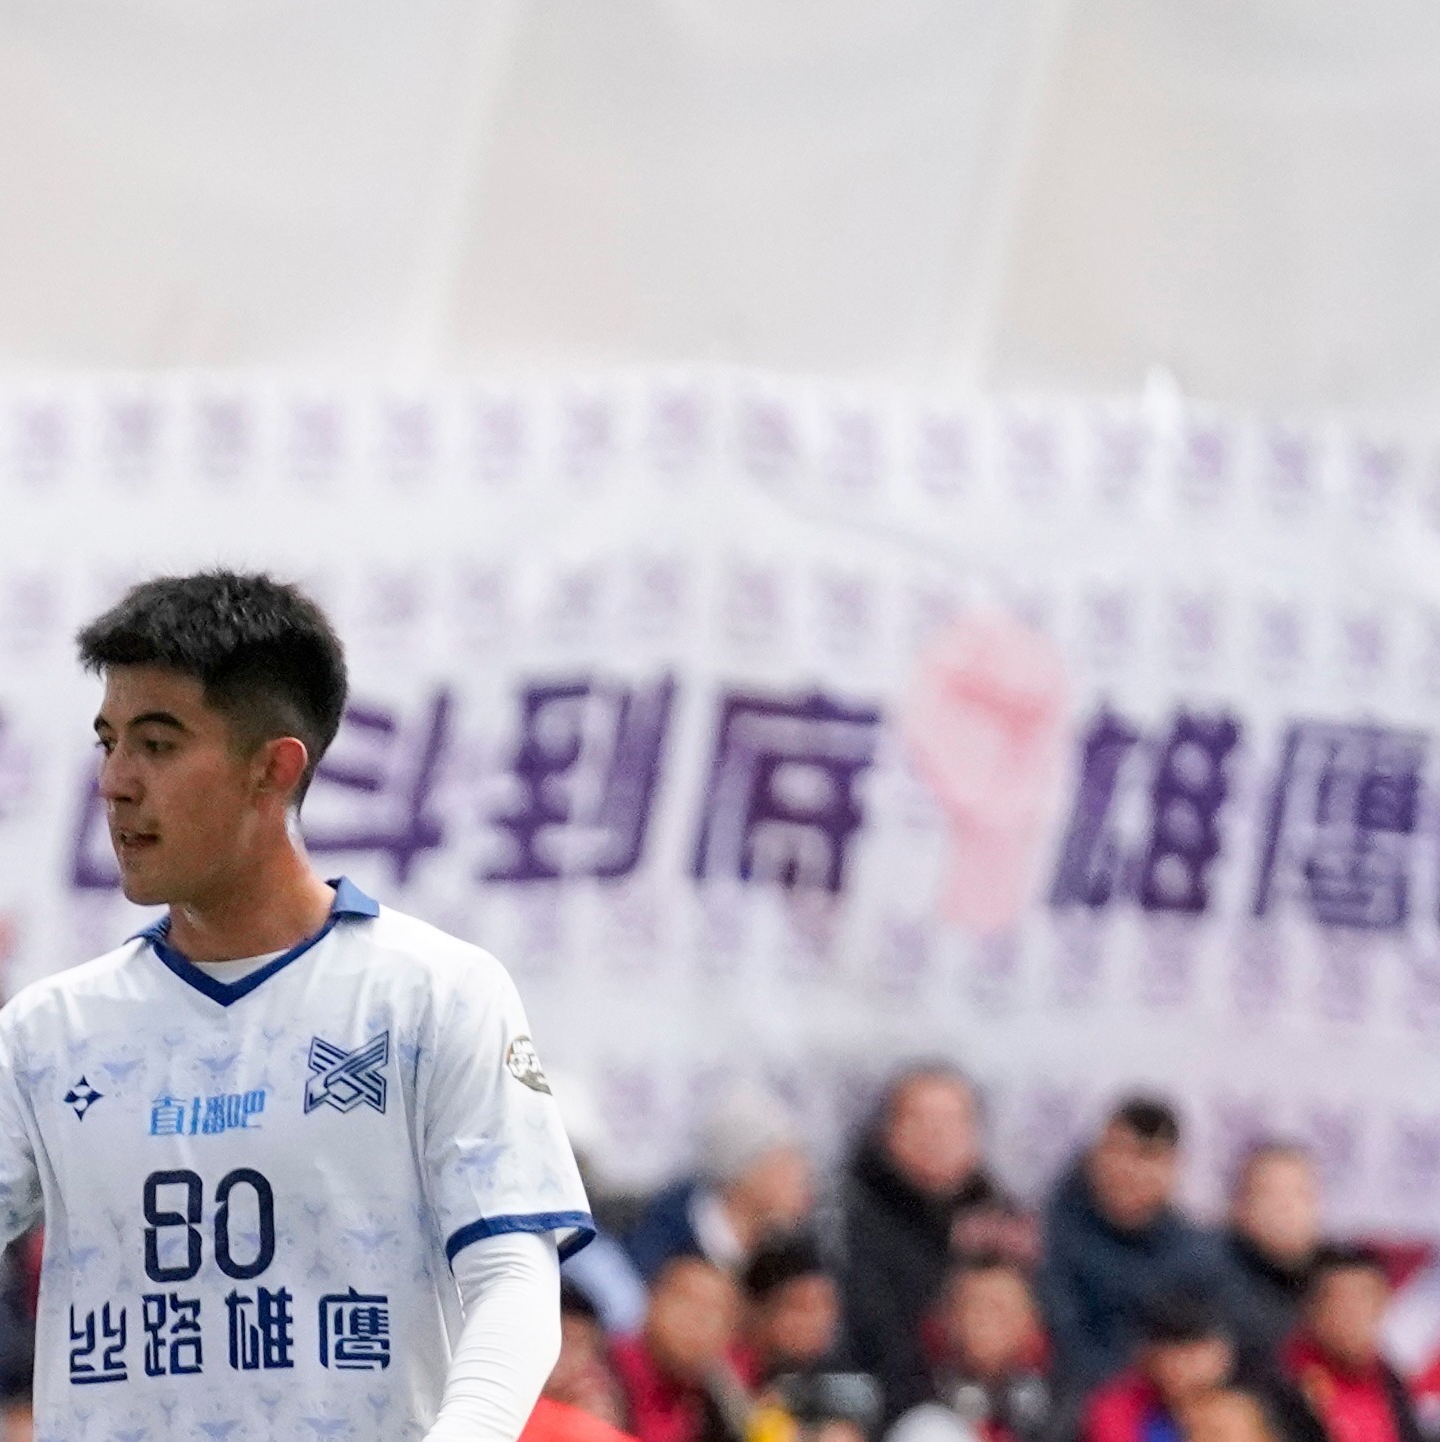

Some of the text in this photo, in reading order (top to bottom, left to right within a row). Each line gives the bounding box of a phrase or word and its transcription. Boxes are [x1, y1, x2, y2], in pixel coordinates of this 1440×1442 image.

[148, 1090, 266, 1136] 直播吧
[142, 1167, 275, 1283] 80
[69, 1286, 391, 1385] 丝路雄鹰
